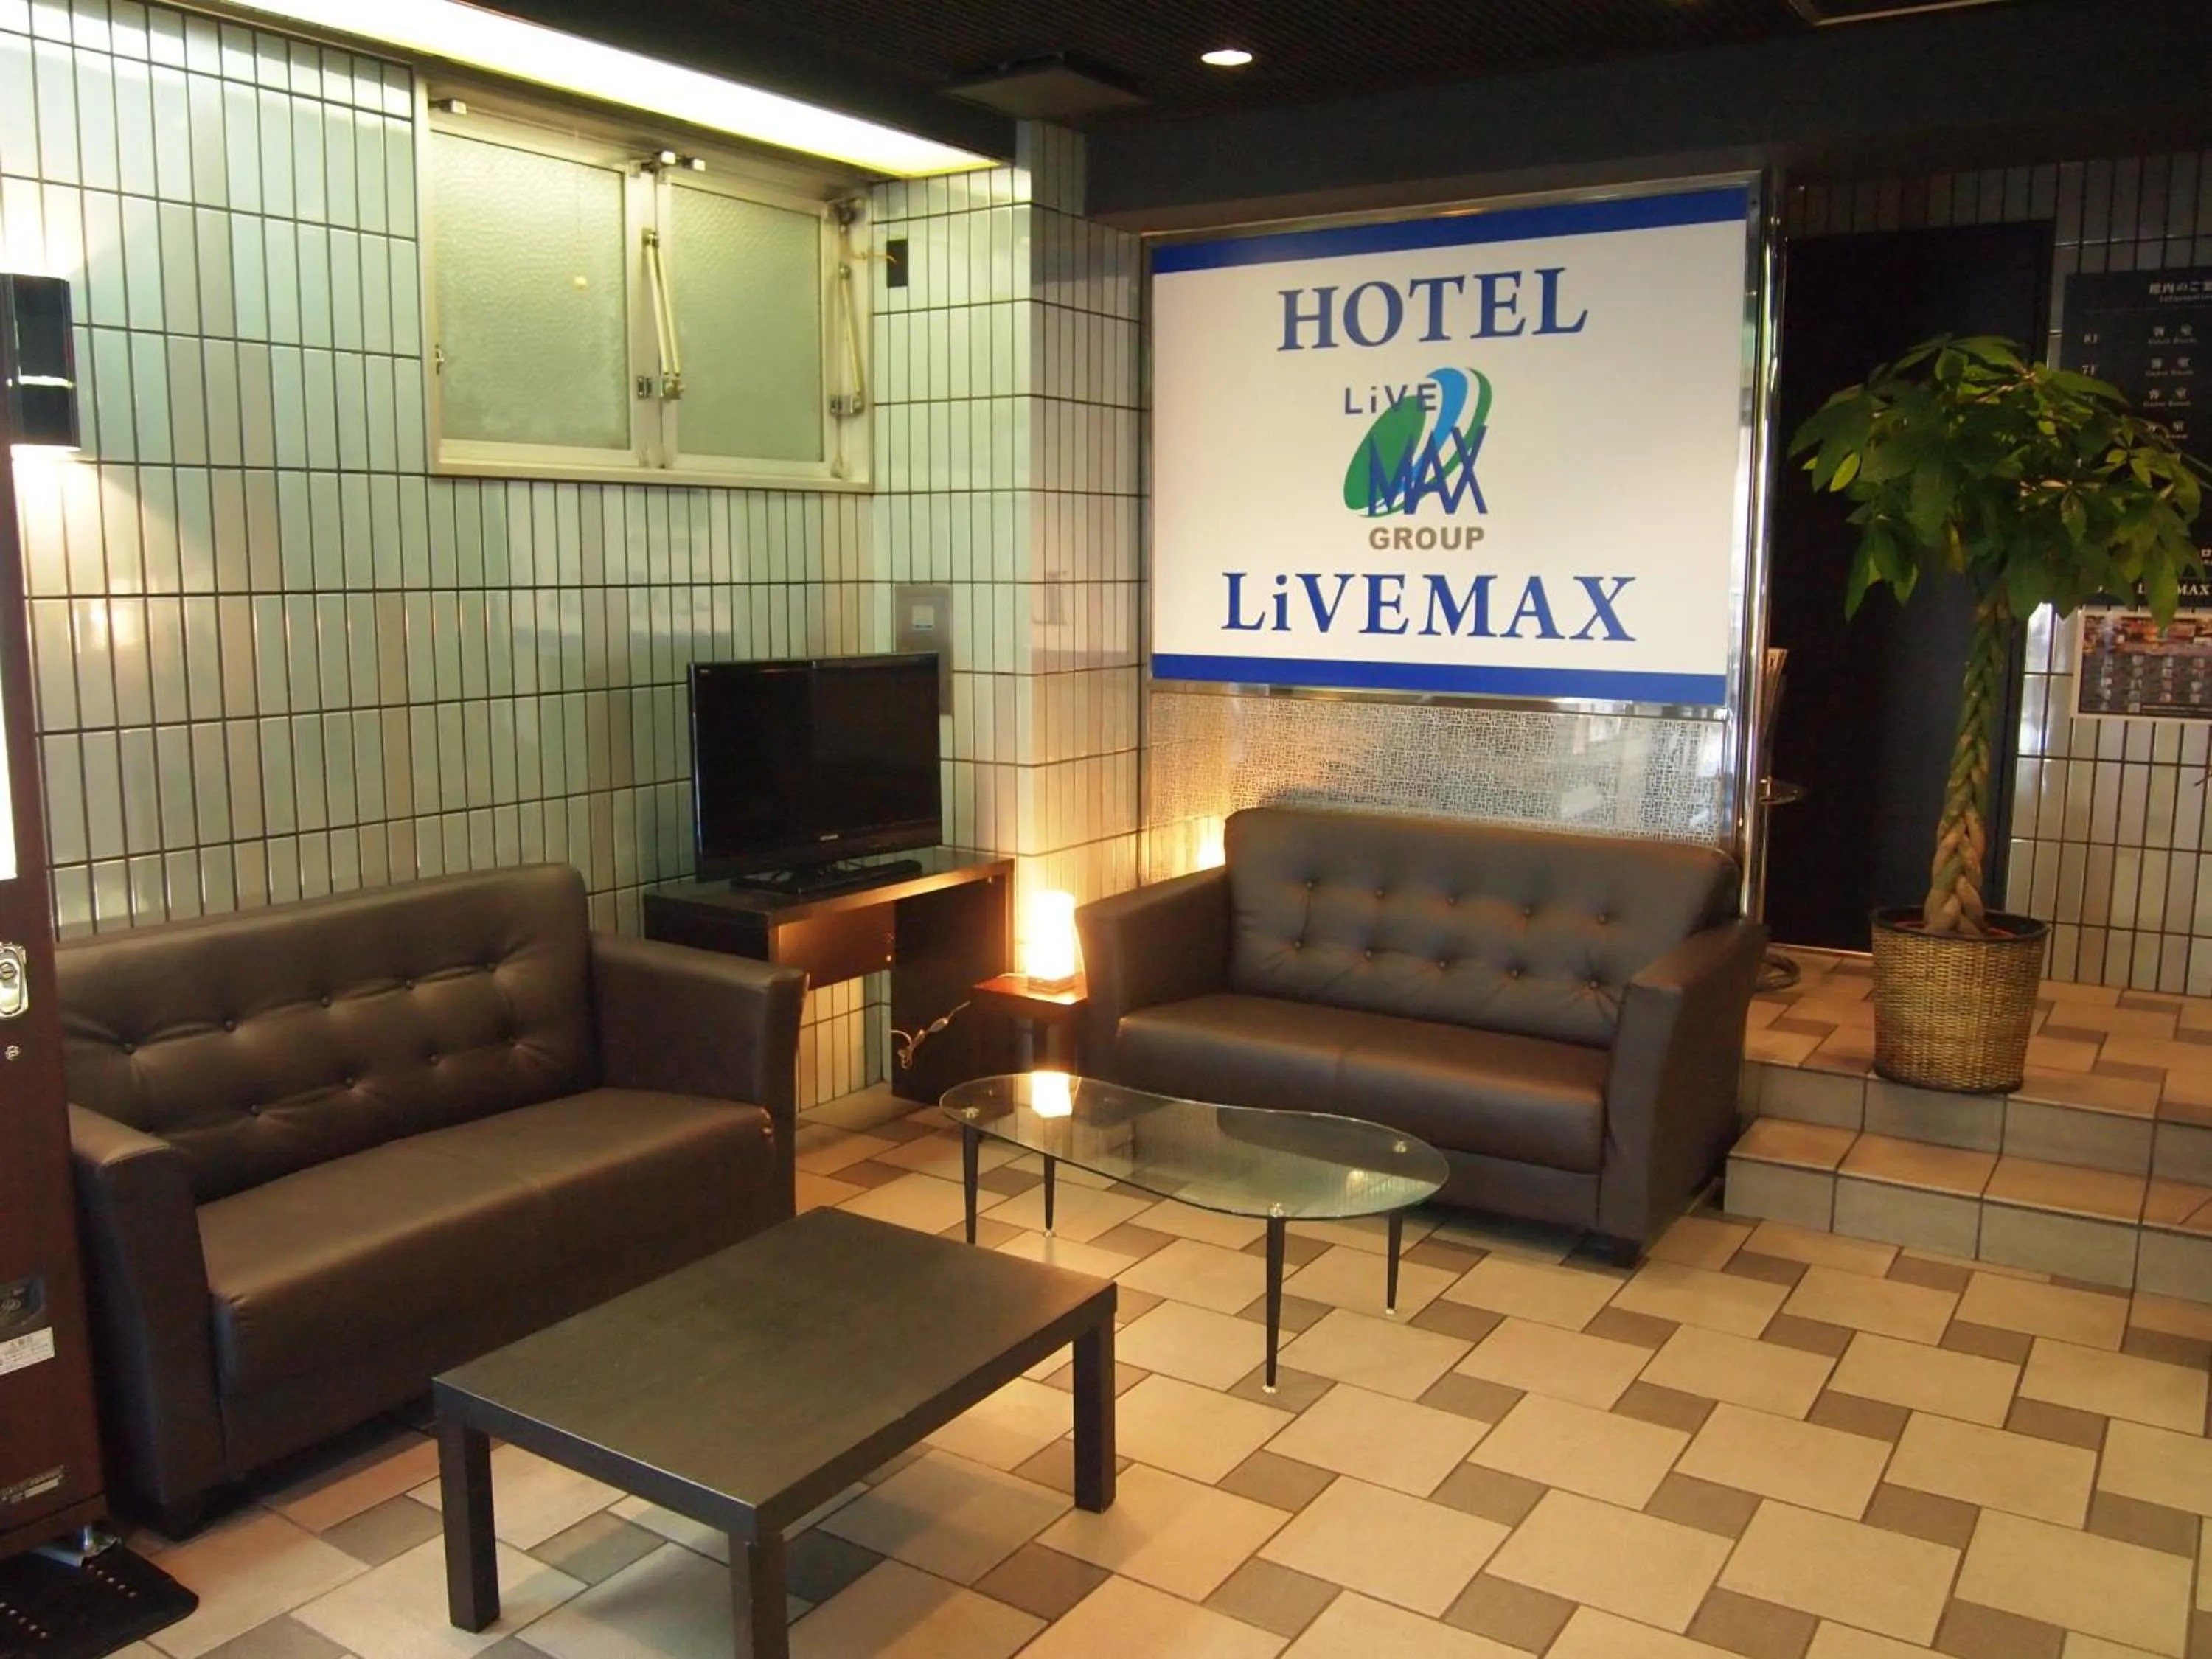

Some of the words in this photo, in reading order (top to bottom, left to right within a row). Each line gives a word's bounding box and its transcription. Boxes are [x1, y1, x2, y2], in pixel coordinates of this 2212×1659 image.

[1277, 267, 1588, 352] HOTEL
[1368, 425, 1489, 516] MAX
[1368, 526, 1486, 552] GROUP
[1222, 572, 1637, 642] LiVEMAX
